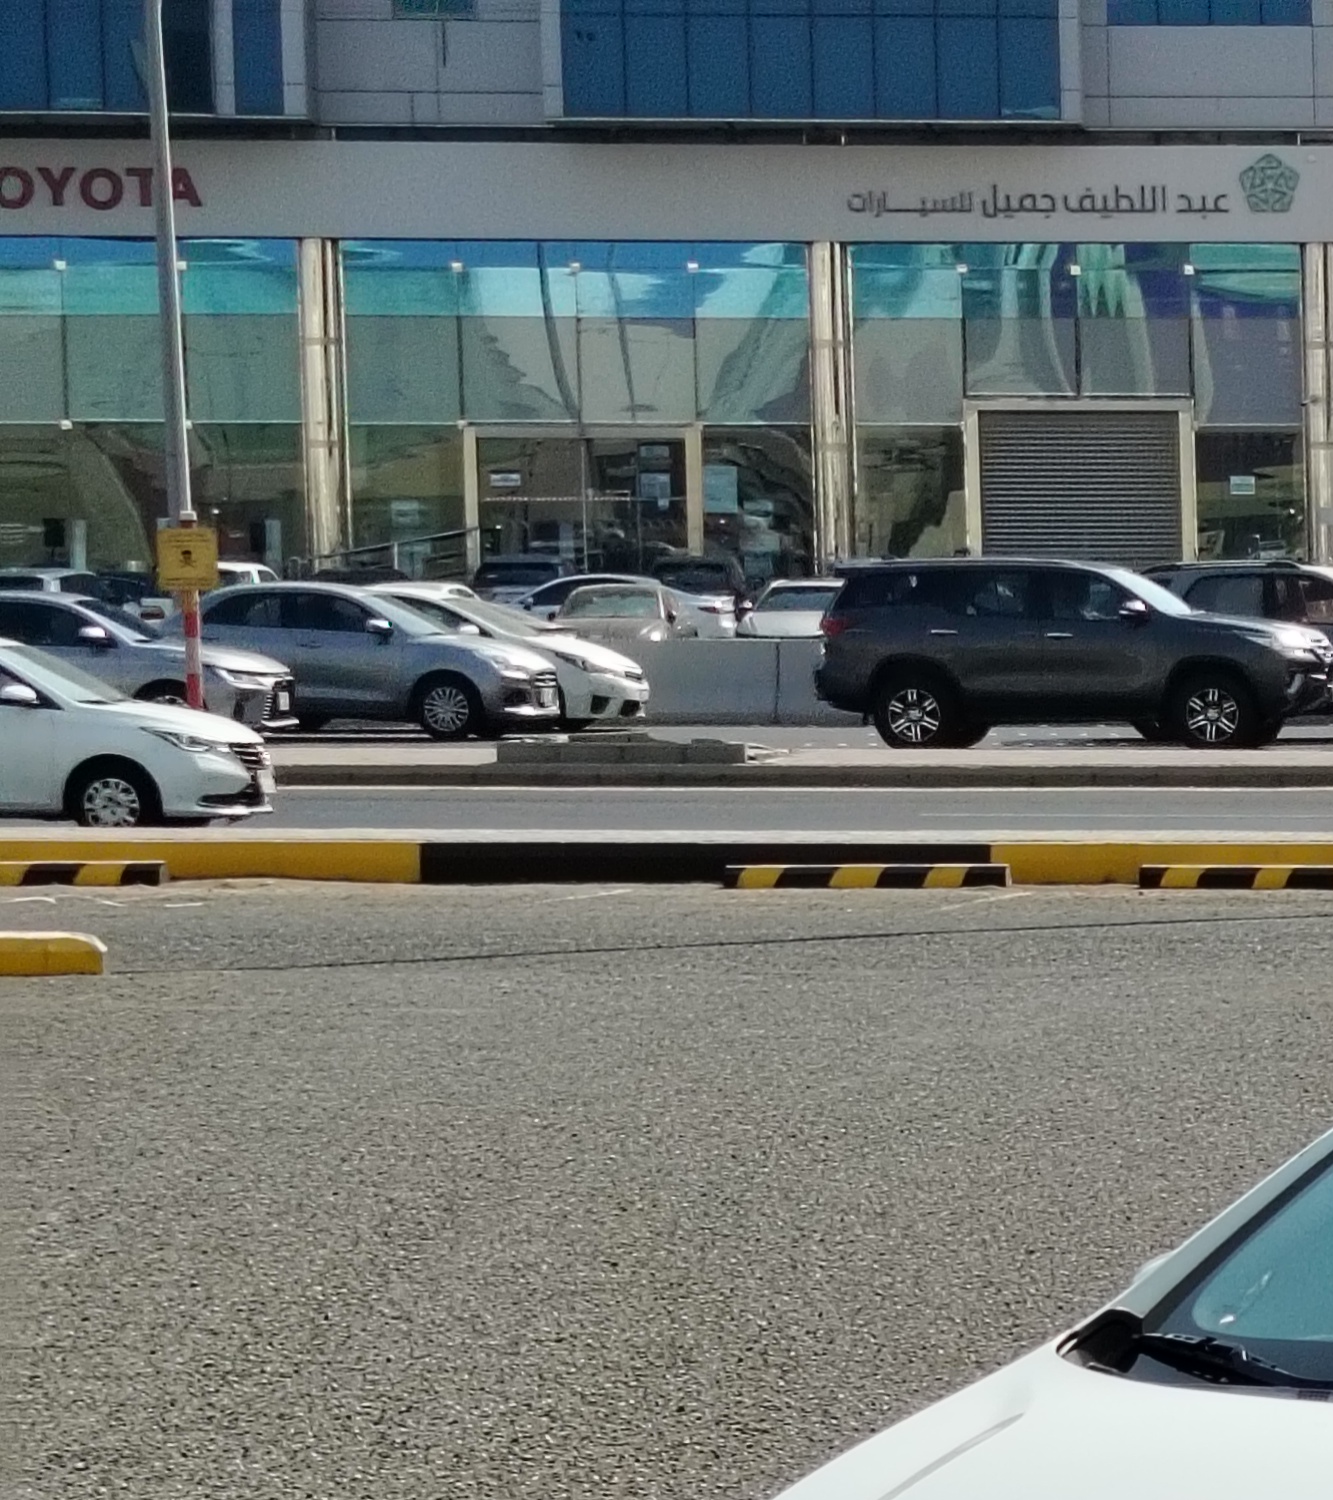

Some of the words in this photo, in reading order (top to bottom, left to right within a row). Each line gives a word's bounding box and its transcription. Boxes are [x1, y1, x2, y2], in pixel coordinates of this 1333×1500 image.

[982, 184, 1057, 219] جميل
[1063, 185, 1167, 219] اللطيف
[1175, 191, 1230, 219] عبد
